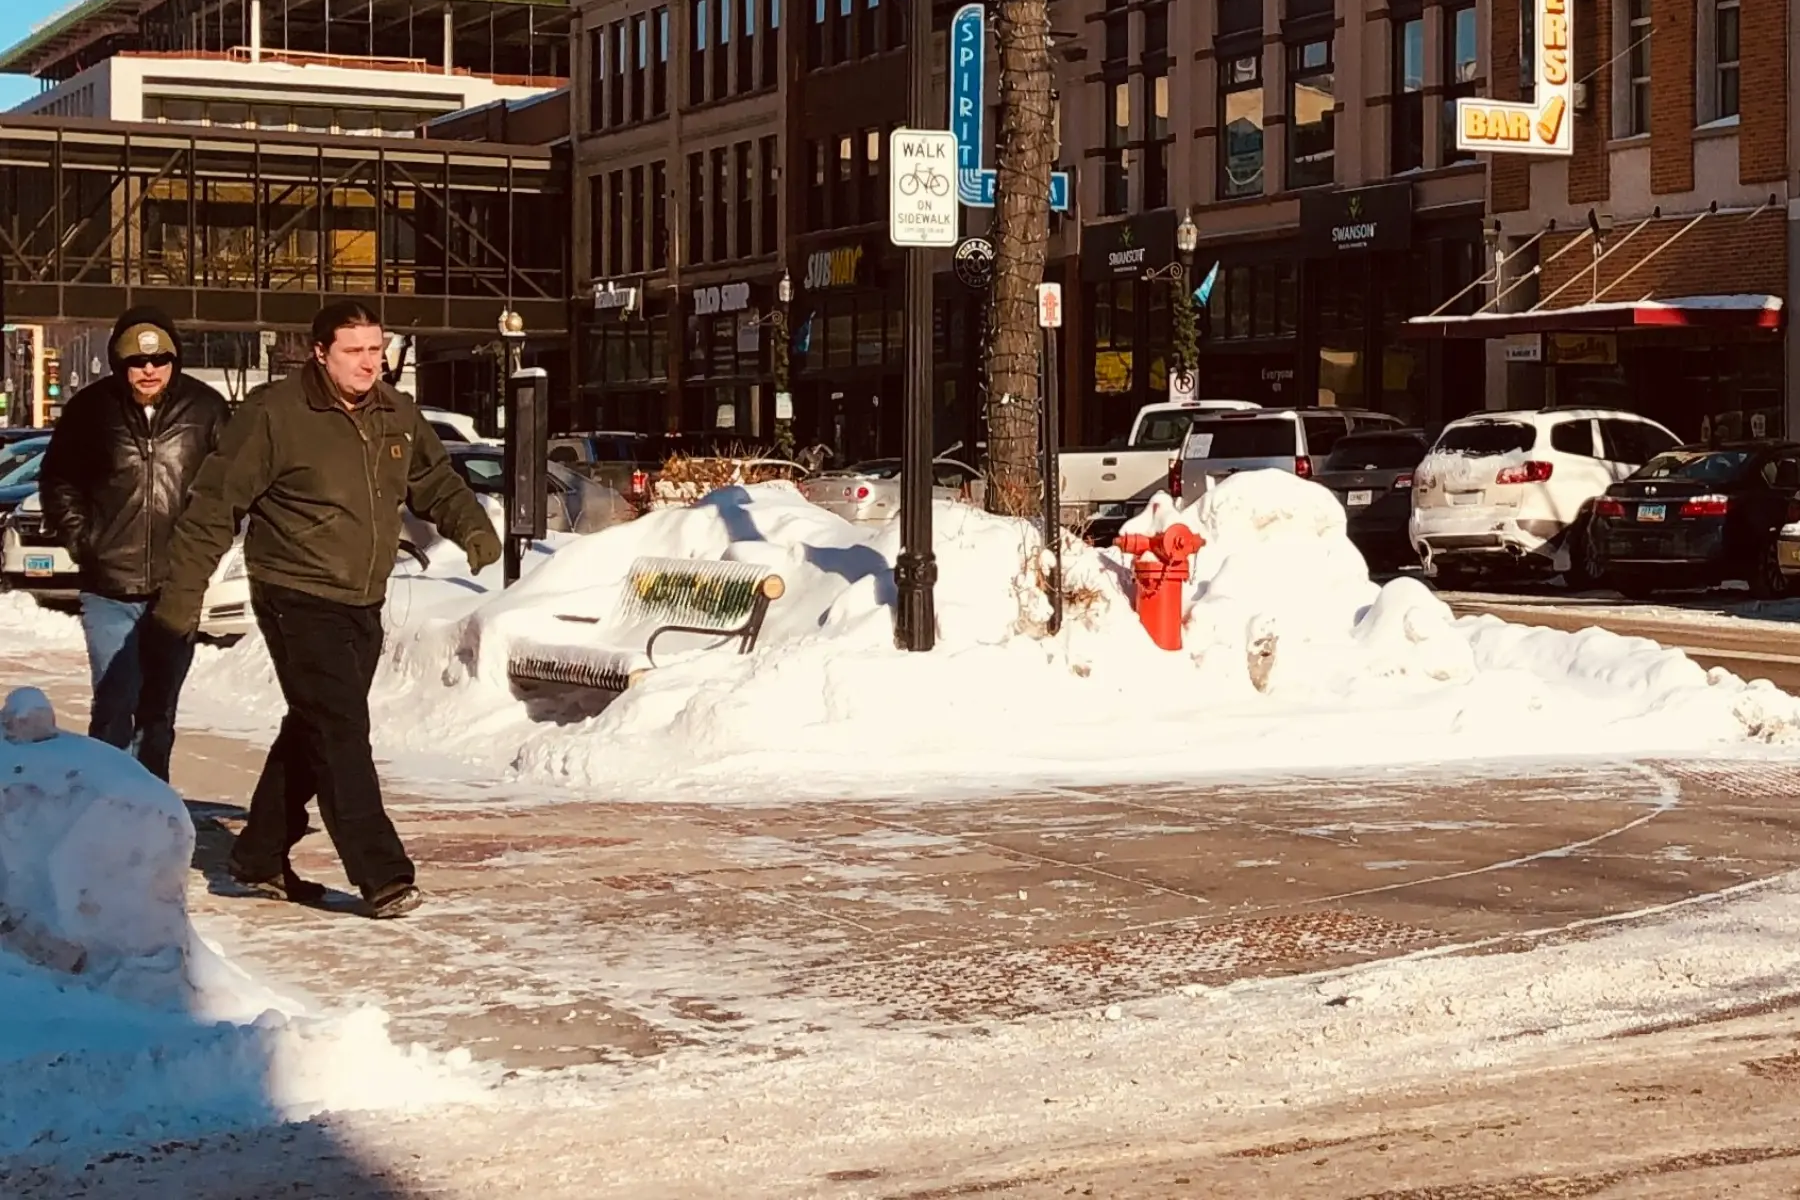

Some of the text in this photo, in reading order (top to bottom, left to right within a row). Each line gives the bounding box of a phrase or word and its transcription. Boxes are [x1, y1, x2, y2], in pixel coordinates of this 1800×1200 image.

[959, 22, 974, 166] SPIRIT
[1465, 107, 1530, 142] BAR
[903, 143, 946, 158] WALK
[917, 200, 932, 211] ON
[898, 213, 950, 225] SIDEWALK
[1331, 223, 1374, 242] SWANSON
[804, 247, 862, 290] SUBWAY
